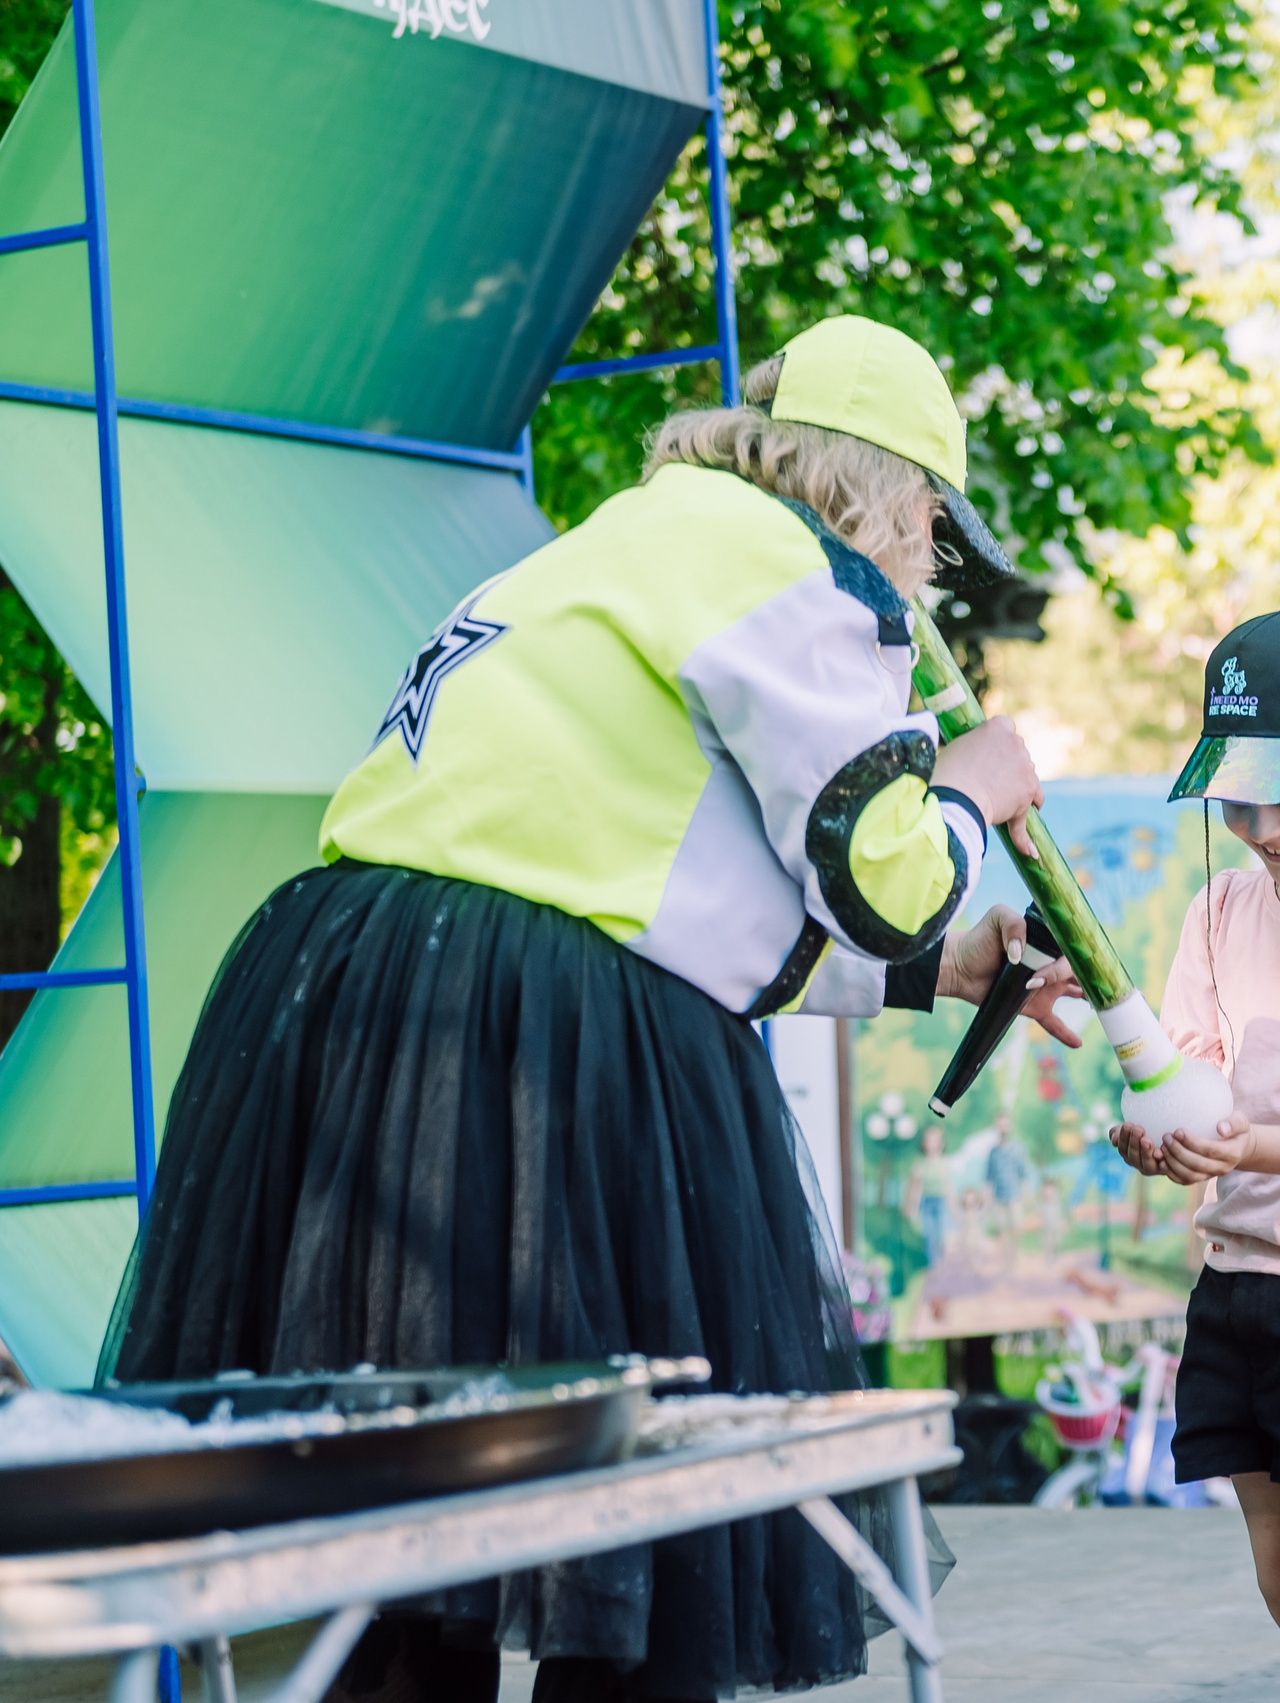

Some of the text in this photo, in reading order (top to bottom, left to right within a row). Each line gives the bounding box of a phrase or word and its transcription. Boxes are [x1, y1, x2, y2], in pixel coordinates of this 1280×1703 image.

[1214, 695, 1237, 705] NEED
[1239, 695, 1259, 706] MO
[1220, 704, 1258, 717] SPACE
